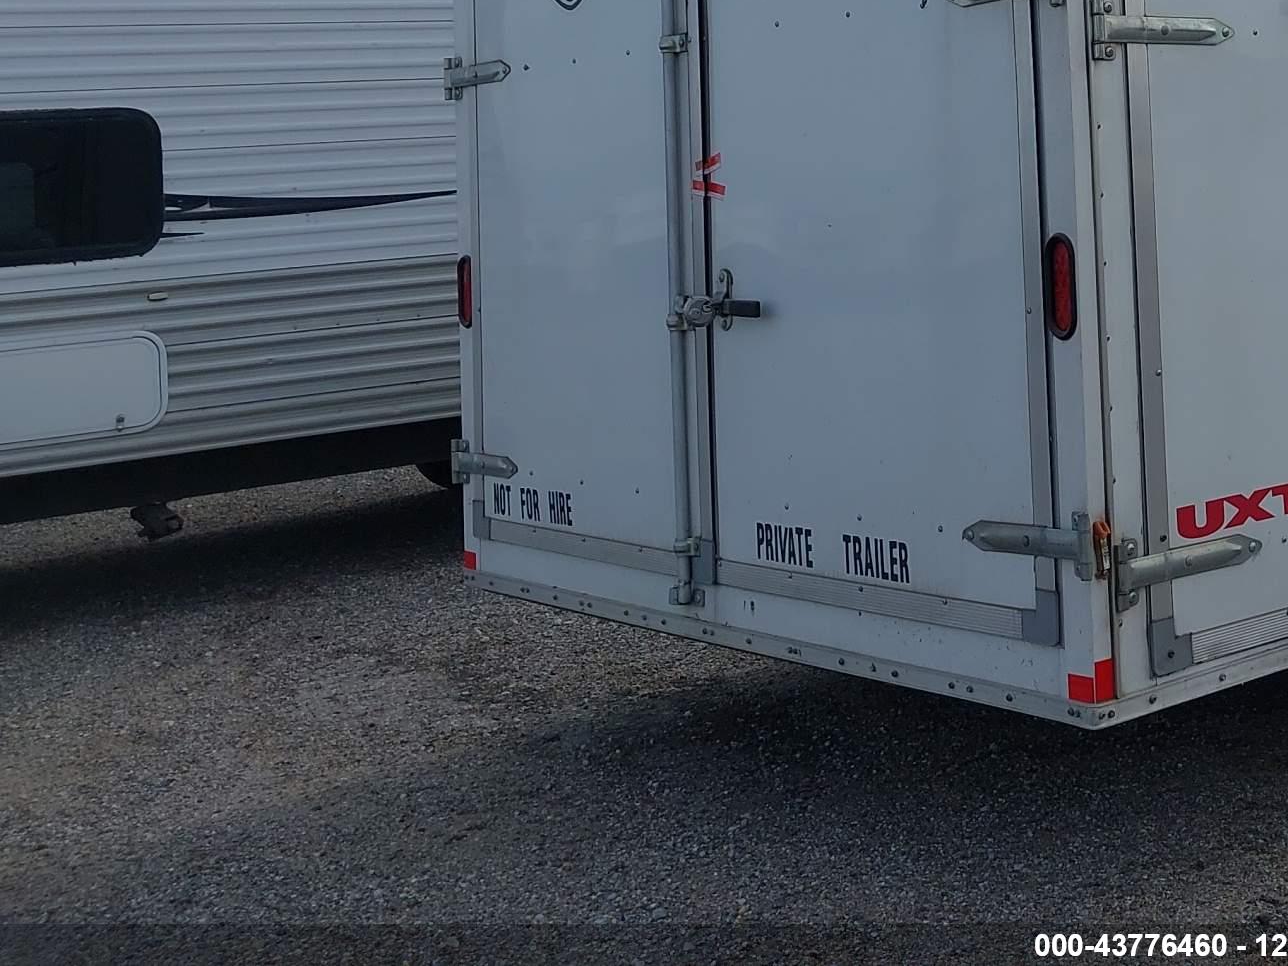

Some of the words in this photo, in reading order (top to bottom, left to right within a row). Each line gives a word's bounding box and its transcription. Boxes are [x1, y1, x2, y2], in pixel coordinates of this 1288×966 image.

[493, 482, 511, 516] NOT
[520, 487, 540, 521] FOR
[548, 490, 573, 526] HIRE
[756, 522, 813, 569] PRIVATE
[842, 534, 910, 584] TRAILER
